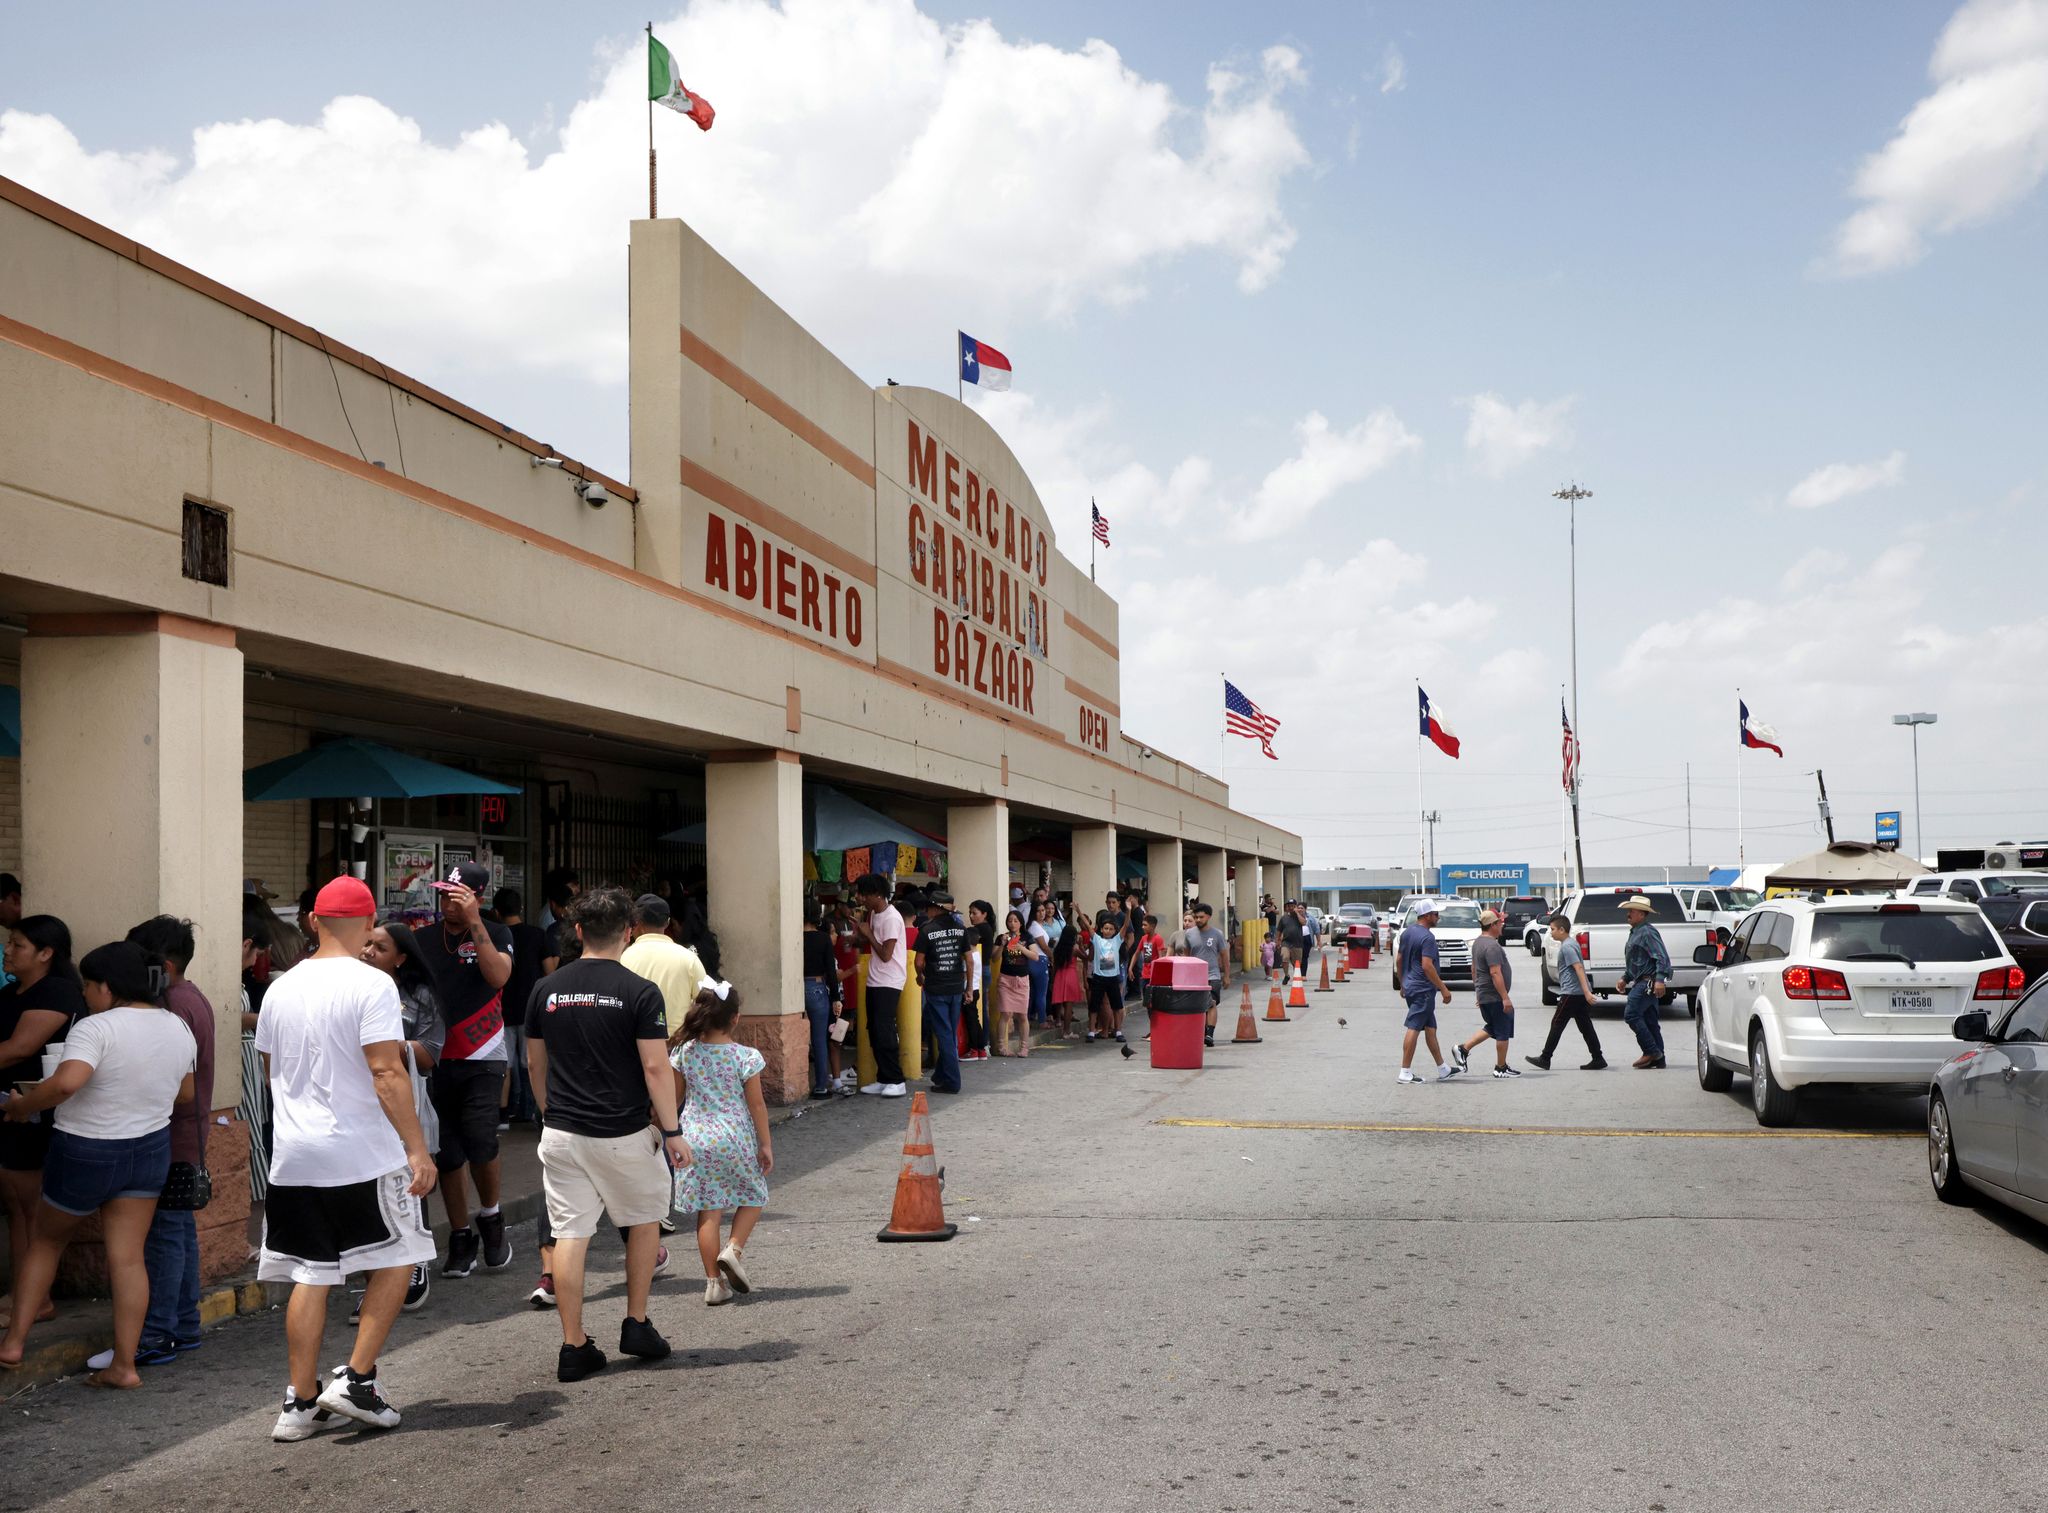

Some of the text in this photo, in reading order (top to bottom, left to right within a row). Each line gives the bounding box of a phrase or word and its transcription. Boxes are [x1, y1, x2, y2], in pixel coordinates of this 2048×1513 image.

[908, 418, 1048, 587] MERCADO
[705, 512, 862, 647] ABIERTO
[908, 503, 1048, 658] GARIBALDI
[934, 606, 1034, 715] BAZAAR
[1079, 704, 1108, 753] OPEN
[481, 796, 506, 823] PEN
[395, 854, 427, 867] OPEN
[443, 854, 469, 865] BIERTO
[1469, 869, 1524, 879] CHEVROLET
[927, 930, 947, 940] GEORGE
[558, 993, 595, 1003] COLLEGIATE
